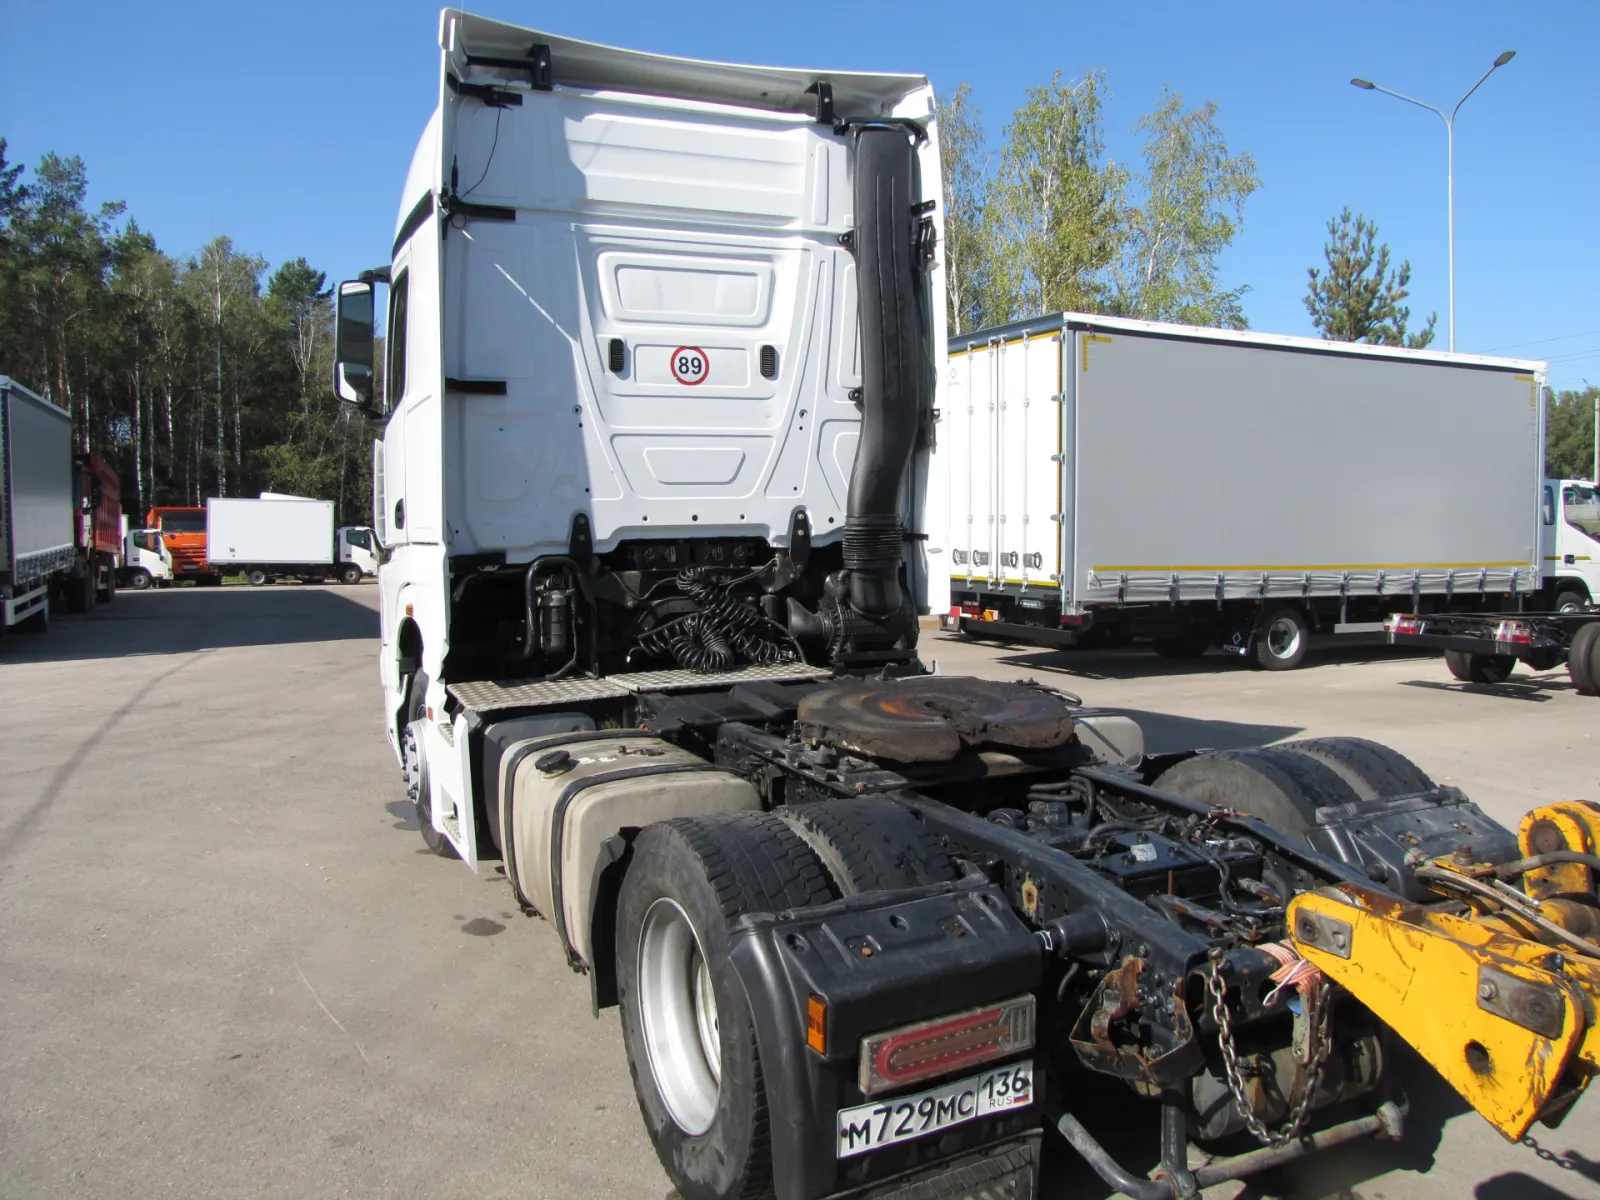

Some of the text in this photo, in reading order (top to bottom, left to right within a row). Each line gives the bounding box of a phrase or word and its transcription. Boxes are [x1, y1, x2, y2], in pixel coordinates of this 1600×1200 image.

[678, 356, 702, 375] 89
[982, 1067, 1026, 1100] 136
[989, 1096, 1013, 1108] RUS
